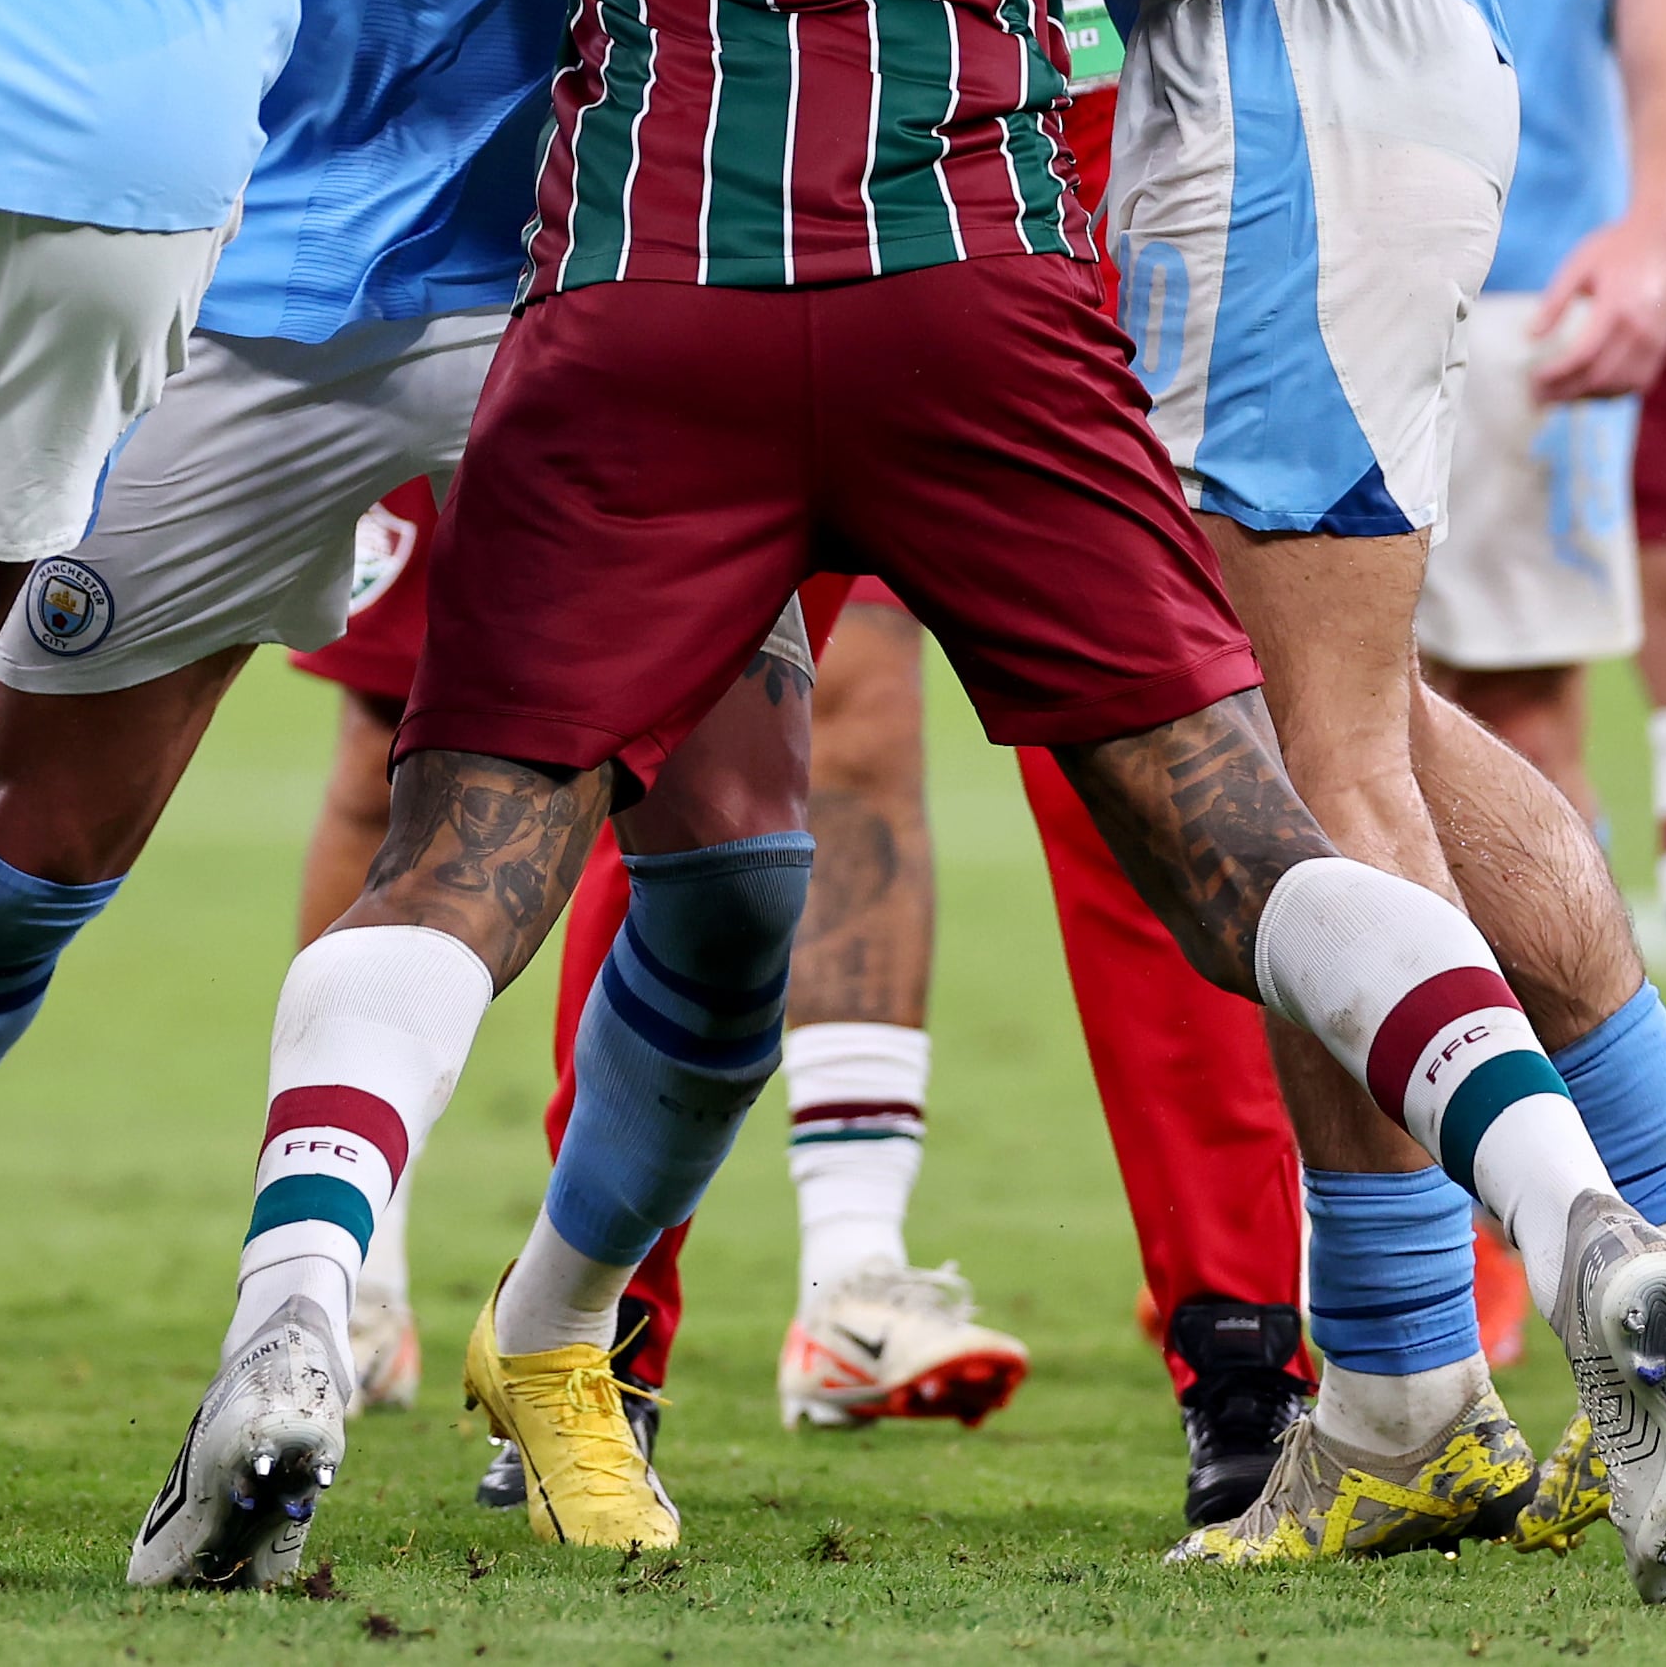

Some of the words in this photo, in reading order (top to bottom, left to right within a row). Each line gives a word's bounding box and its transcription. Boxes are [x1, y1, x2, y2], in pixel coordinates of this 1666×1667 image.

[39, 564, 105, 606] MANCHESTER
[42, 633, 69, 650] CITY
[1425, 1025, 1490, 1085] FFC
[284, 1140, 359, 1163] FFC
